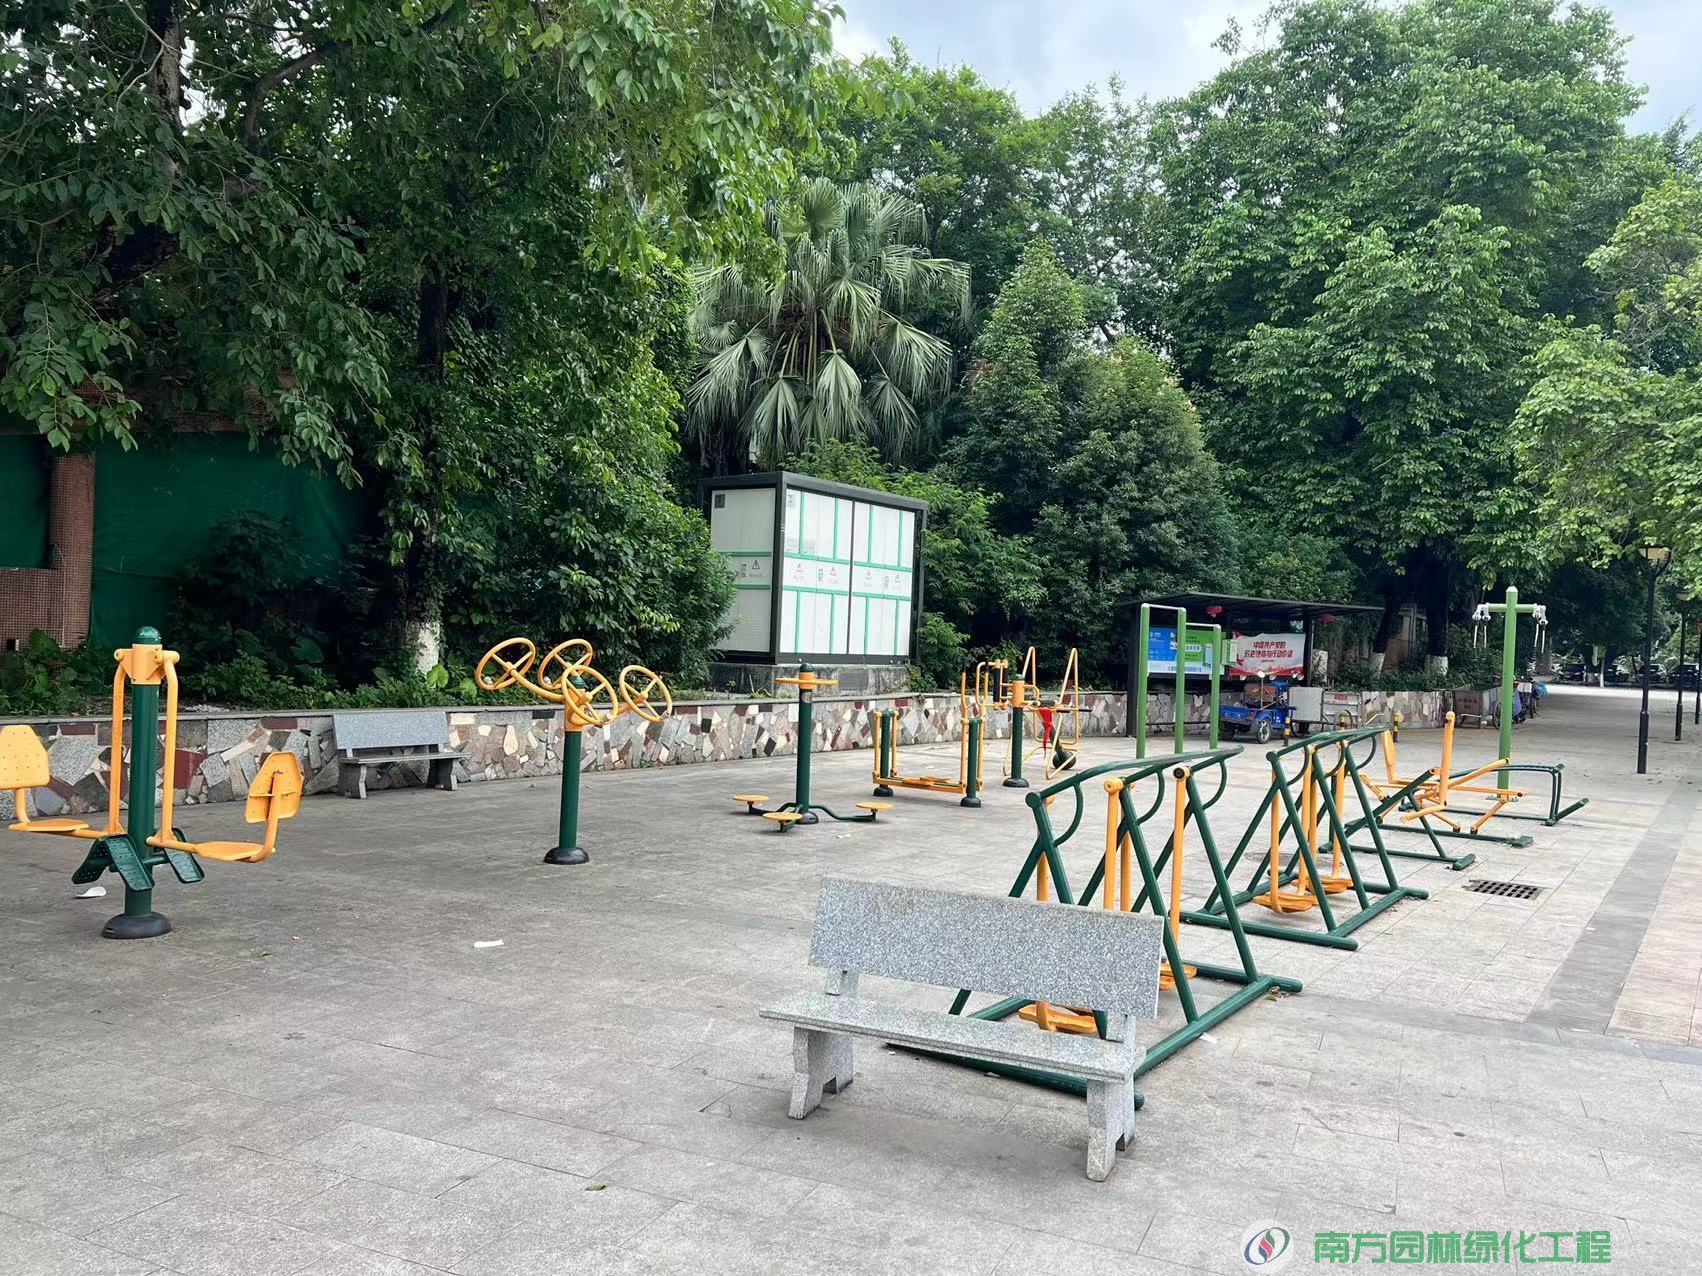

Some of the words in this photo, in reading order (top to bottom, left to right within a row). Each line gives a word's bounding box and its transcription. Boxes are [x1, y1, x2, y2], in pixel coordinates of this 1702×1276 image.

[1253, 641, 1286, 649] 中国共产党的
